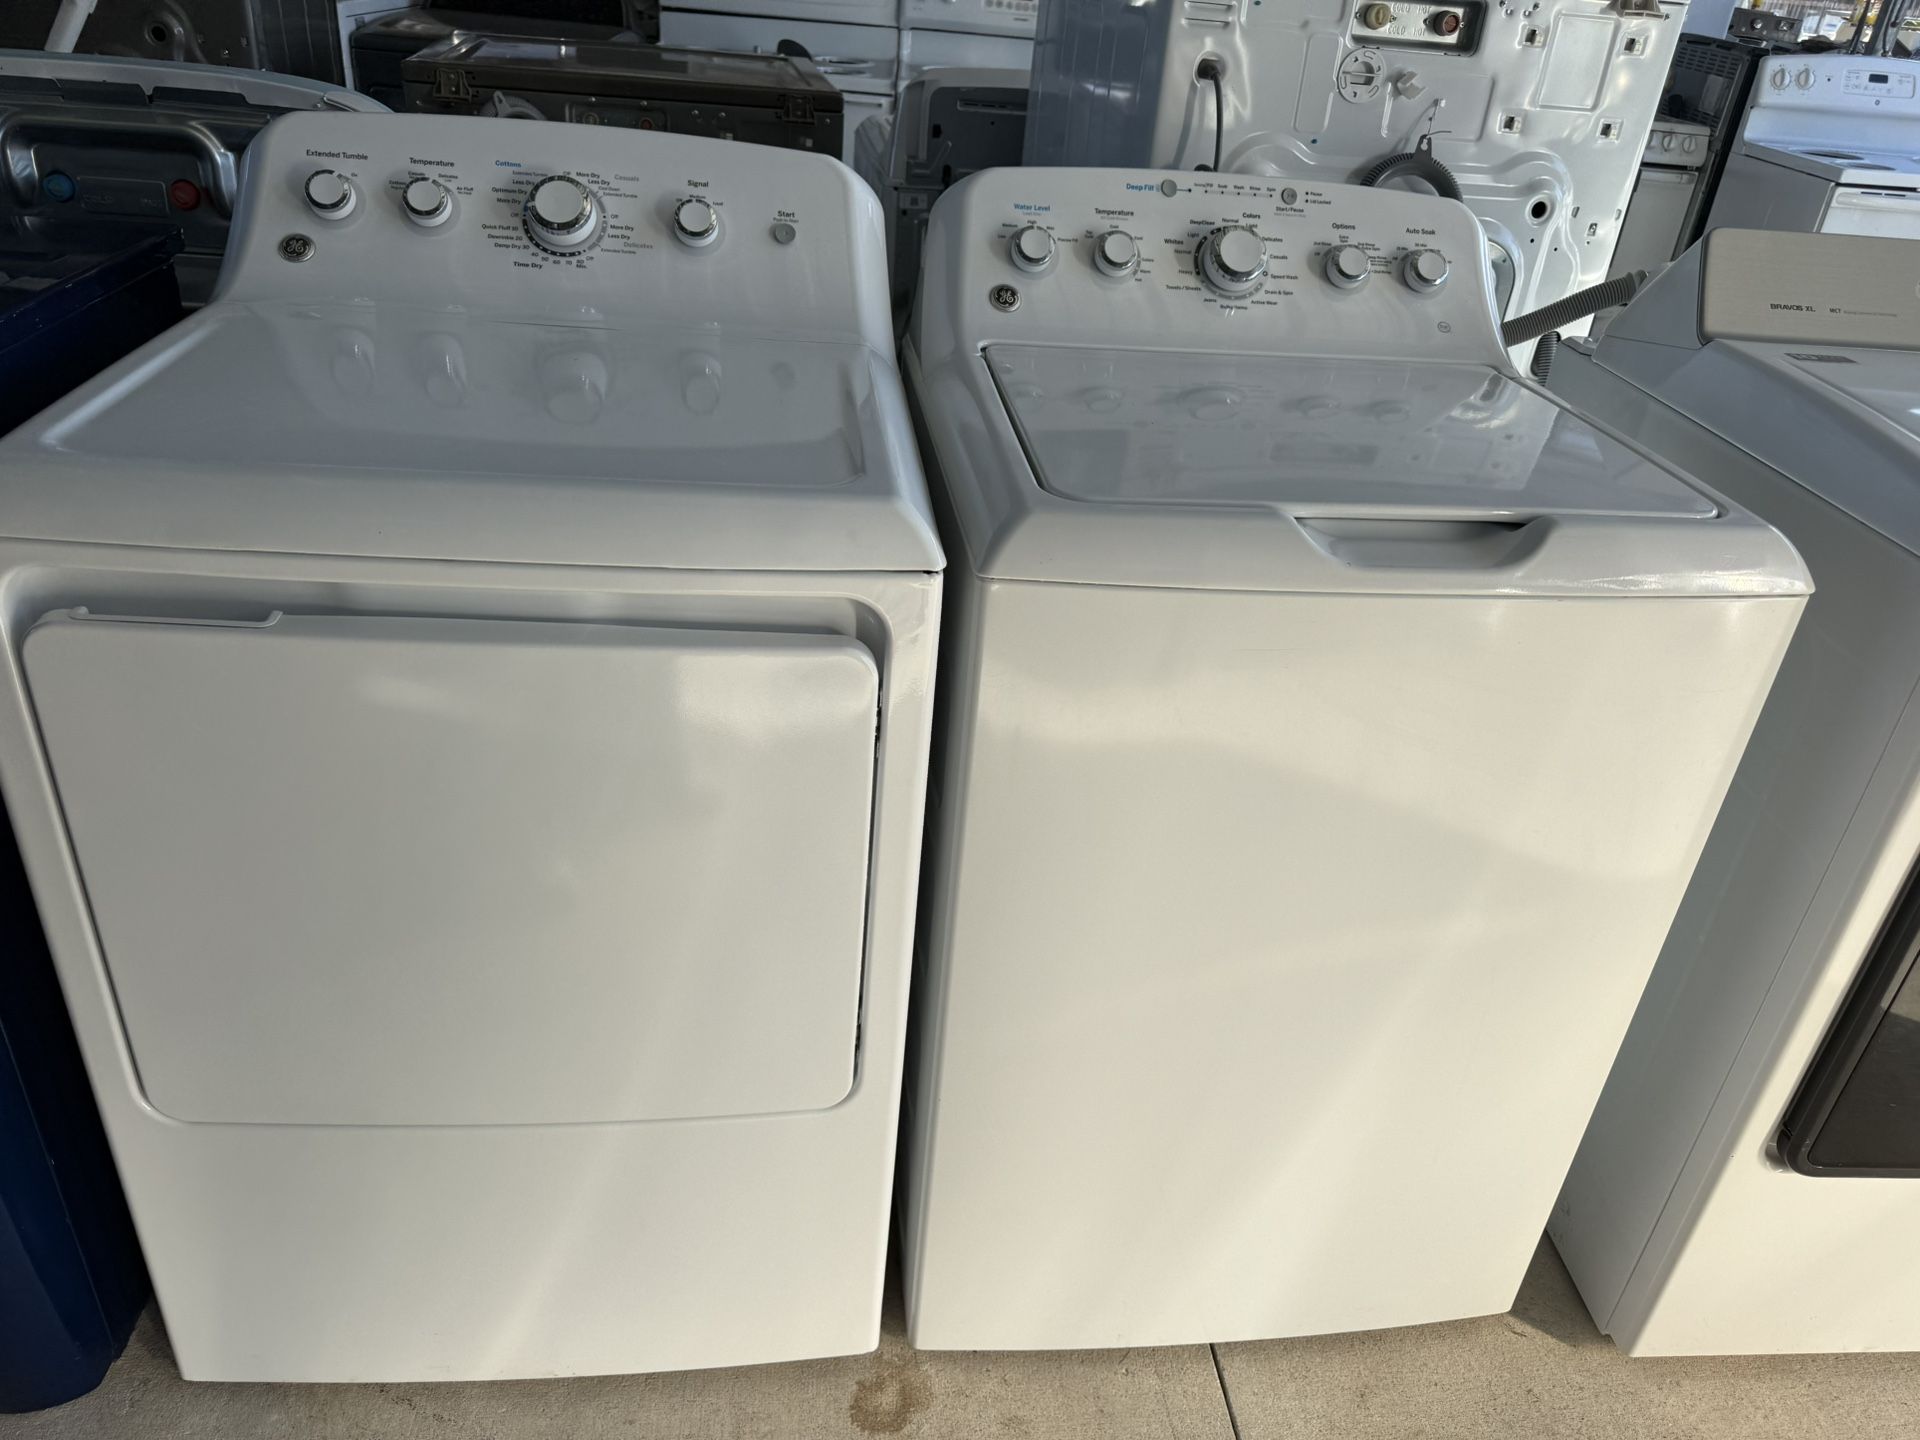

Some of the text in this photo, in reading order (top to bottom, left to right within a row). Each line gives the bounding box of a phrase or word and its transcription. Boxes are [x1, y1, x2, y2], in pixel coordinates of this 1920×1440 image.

[306, 149, 368, 160] Extended Tumble
[409, 157, 454, 168] Temperature
[687, 180, 709, 188] Signal
[1126, 183, 1143, 192] Deep
[1095, 208, 1134, 216] Temperature
[1770, 303, 1803, 312] BRAVOS
